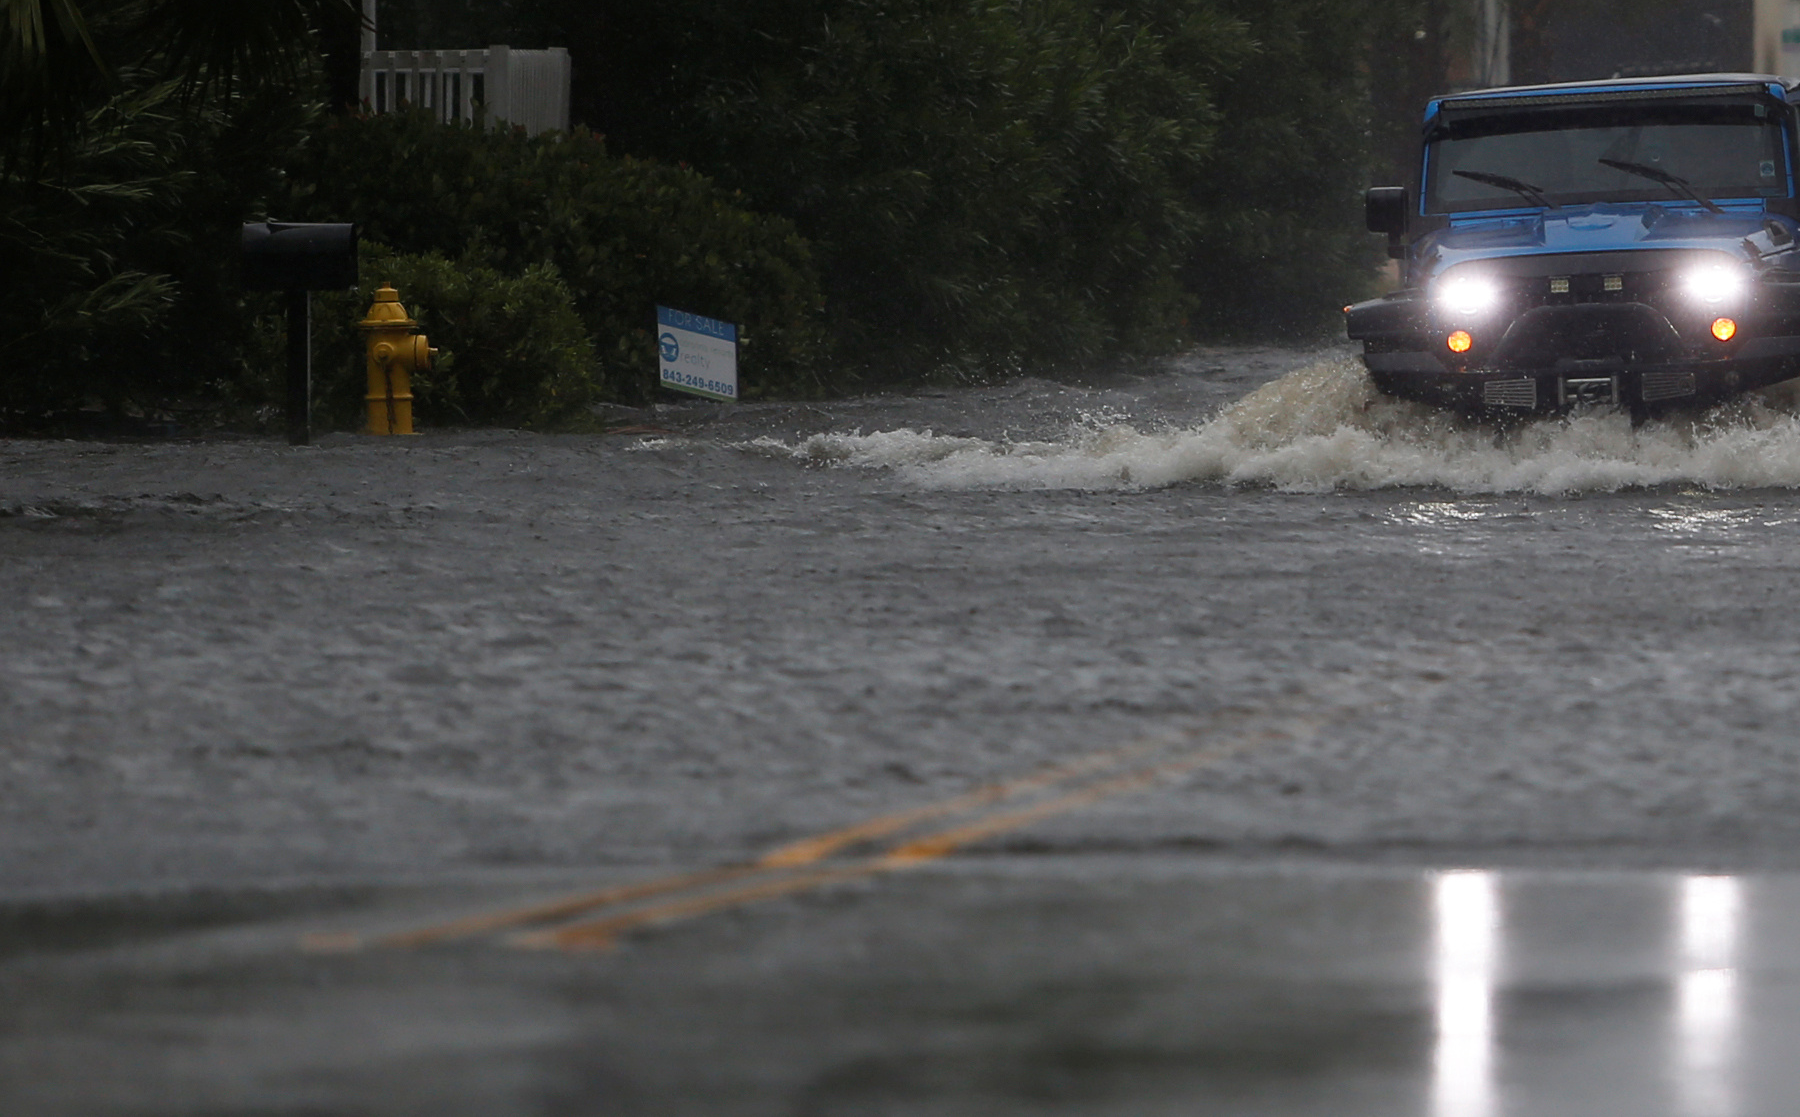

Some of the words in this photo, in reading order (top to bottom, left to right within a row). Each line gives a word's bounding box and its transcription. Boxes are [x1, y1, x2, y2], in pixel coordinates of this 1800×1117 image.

[668, 308, 691, 327] FOR
[695, 315, 724, 335] SALE
[680, 352, 710, 369] realty
[662, 368, 733, 395] 843-249-6509
